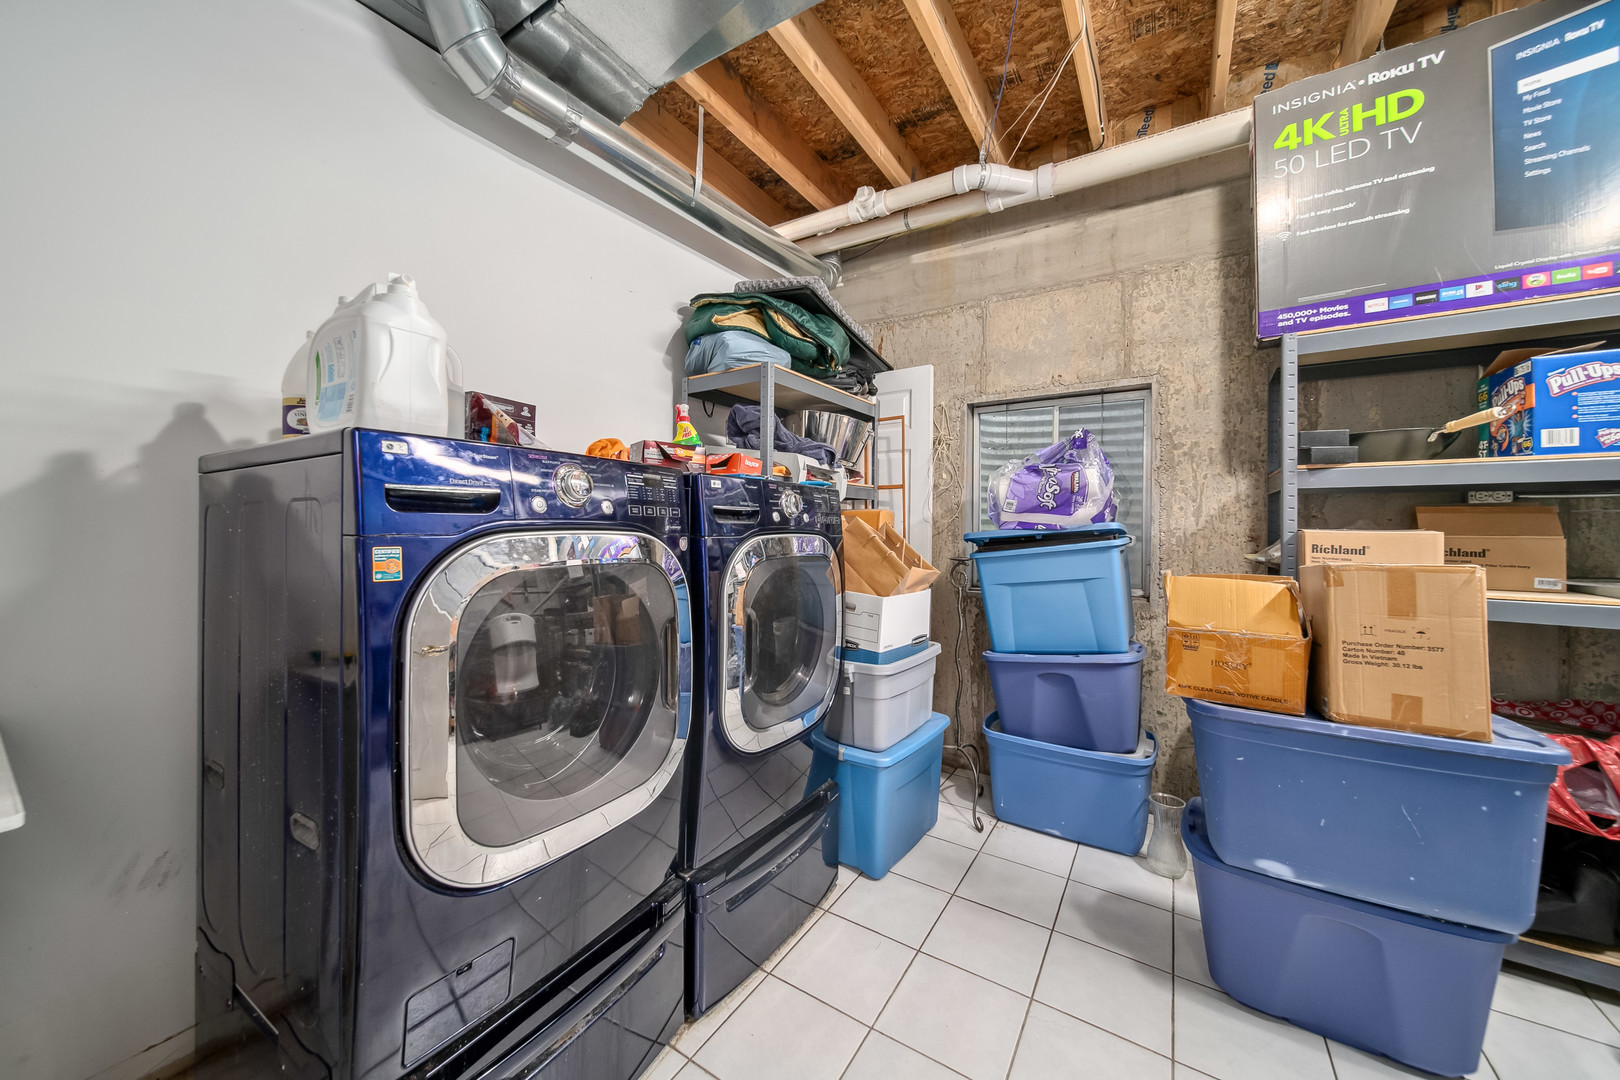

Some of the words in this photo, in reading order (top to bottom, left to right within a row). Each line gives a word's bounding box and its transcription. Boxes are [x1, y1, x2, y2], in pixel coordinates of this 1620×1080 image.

[1272, 81, 1356, 115] INSIGNIA
[1367, 62, 1415, 86] Roku
[1417, 50, 1446, 70] TV
[1522, 104, 1542, 114] Movie
[1542, 98, 1562, 108] Store
[1273, 110, 1336, 150] 4K
[1338, 107, 1349, 136] ULTRA
[1352, 88, 1425, 132] HD
[1522, 119, 1533, 127] TV
[1534, 114, 1552, 124] Store
[1523, 130, 1542, 140] News
[1274, 154, 1305, 178] 50
[1315, 138, 1370, 168] LED
[1380, 121, 1423, 150] TV
[1524, 142, 1546, 152] Search
[1524, 152, 1558, 165] Streaming
[1558, 145, 1591, 157] Channels
[1345, 182, 1372, 192] antenna
[1384, 174, 1398, 182] and
[1398, 166, 1436, 179] streaming
[1524, 167, 1552, 178] Settings
[1310, 224, 1336, 234] wireless
[1348, 216, 1374, 226] smooth
[1374, 208, 1410, 220] streaming
[1277, 309, 1318, 320] 450,000+
[1320, 304, 1348, 314] Movies
[1278, 319, 1294, 327] and
[1309, 311, 1351, 322] episodes.
[1549, 364, 1620, 394] Pull-Ups
[1478, 392, 1488, 401] 66
[1312, 544, 1366, 556] Richland
[1444, 548, 1486, 558] chland
[1214, 688, 1235, 696] GLASS
[1237, 692, 1259, 700] VOTIVE
[1260, 695, 1288, 704] CANDLE
